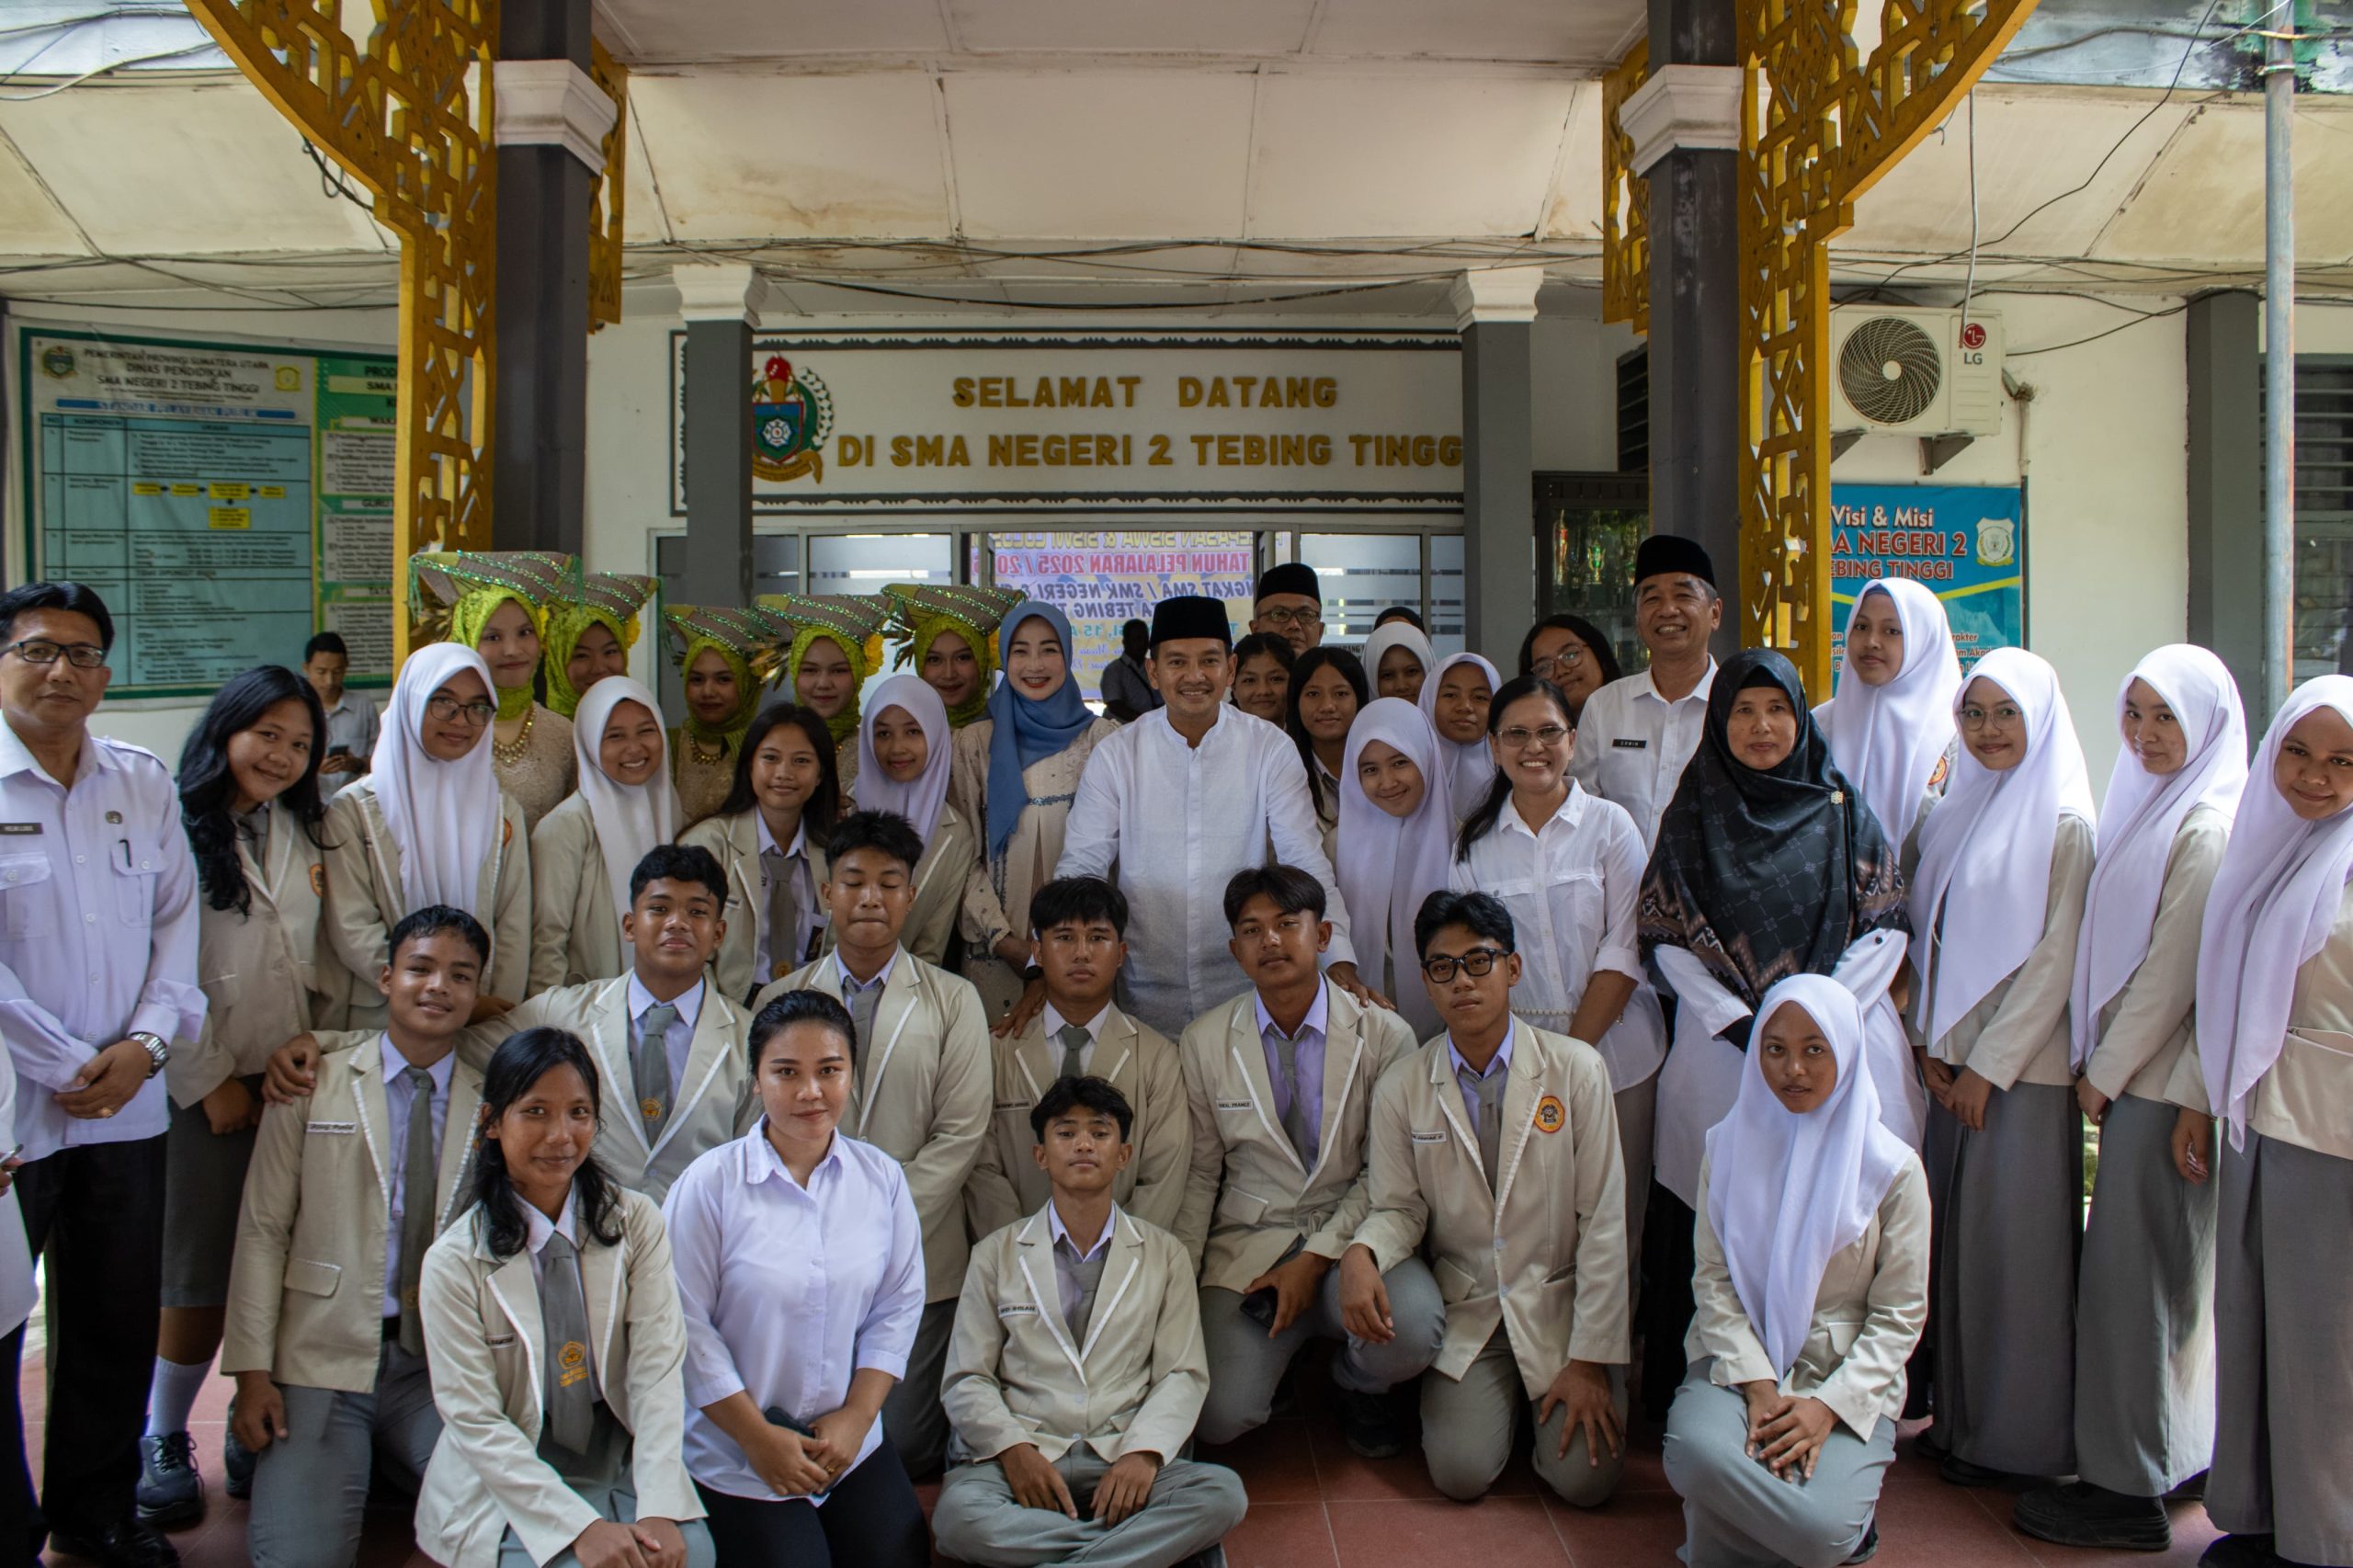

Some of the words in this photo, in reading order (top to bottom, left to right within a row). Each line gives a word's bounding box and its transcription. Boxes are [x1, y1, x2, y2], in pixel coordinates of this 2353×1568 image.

[1964, 353, 1983, 365] LG
[127, 363, 160, 374] DINAS
[164, 365, 232, 378] PENDIDIKAN
[97, 375, 121, 386] SMA
[125, 377, 167, 388] NEGERI
[171, 379, 177, 390] 2
[181, 380, 220, 392] TEBING
[223, 381, 259, 394] TINGGI
[952, 376, 1141, 407] SELAMAT
[1178, 376, 1336, 407] DATANG
[837, 435, 874, 467] DI
[890, 435, 971, 467] SMA
[988, 434, 1131, 467] NEGERI
[1148, 434, 1173, 465] 2
[1190, 435, 1332, 466] TEBING
[1831, 506, 1866, 527] Visi
[1872, 506, 1888, 527] &
[1894, 506, 1934, 528] Misi
[1858, 530, 1945, 555] NEGERI
[1952, 532, 1967, 556] 2
[1887, 560, 1954, 580] TINGGI
